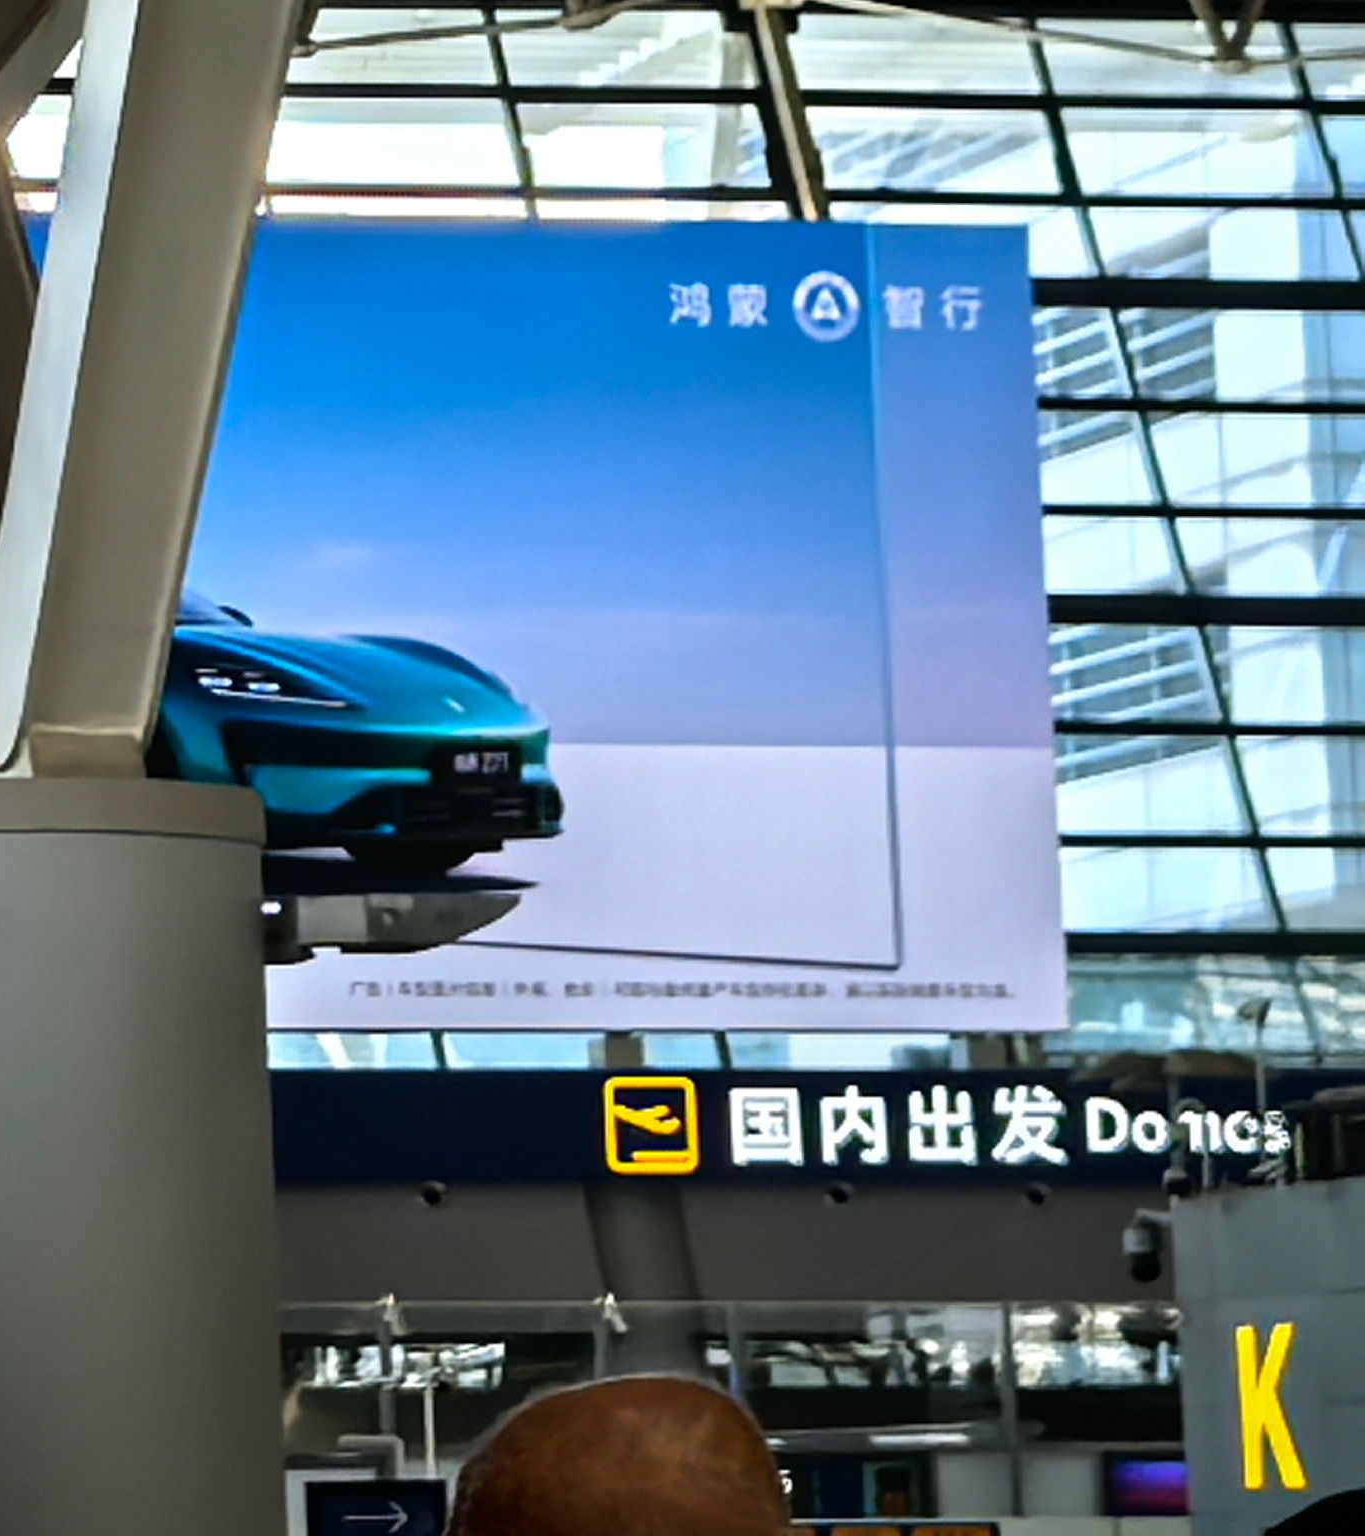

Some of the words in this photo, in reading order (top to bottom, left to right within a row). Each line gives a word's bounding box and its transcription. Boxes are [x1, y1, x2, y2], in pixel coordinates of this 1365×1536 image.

[729, 1084, 1070, 1166] 国内出发
[1235, 1321, 1308, 1491] K
